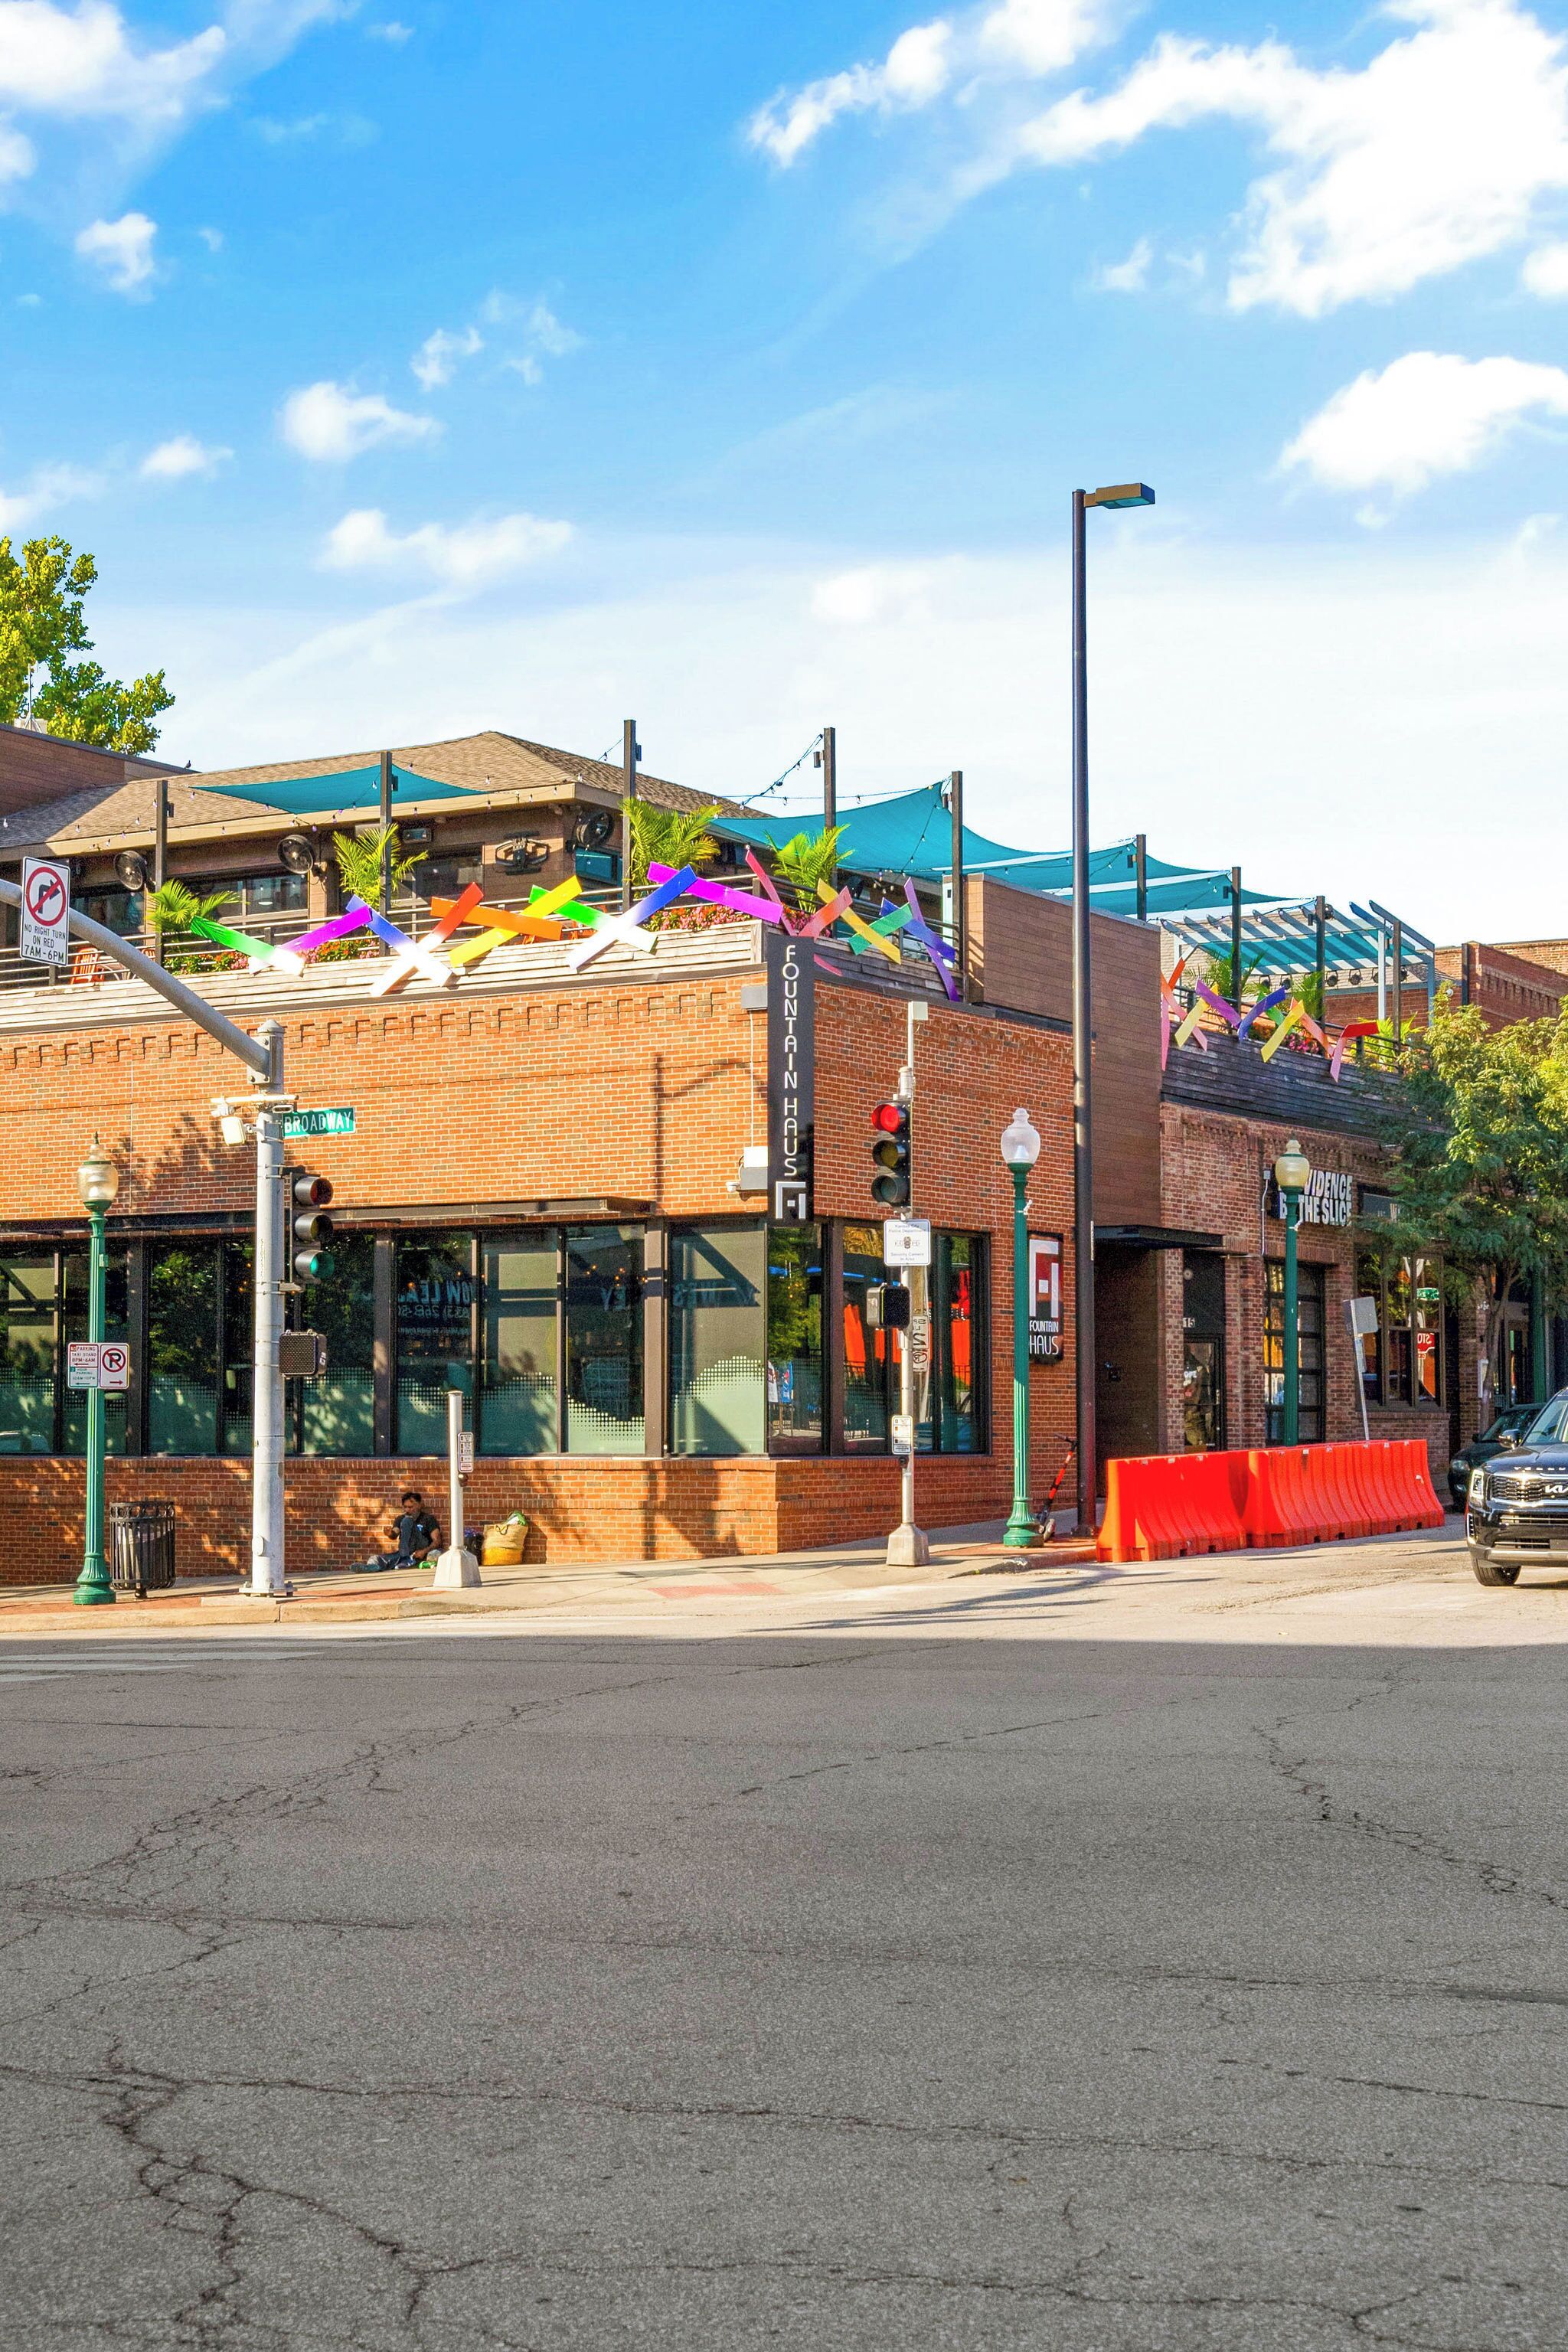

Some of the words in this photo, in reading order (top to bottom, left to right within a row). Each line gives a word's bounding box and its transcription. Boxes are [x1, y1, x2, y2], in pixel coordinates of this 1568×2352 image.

[24, 923, 32, 933] NO
[34, 926, 50, 936] RIGHT
[52, 929, 66, 940] TURN
[33, 935, 41, 945] ON
[44, 937, 54, 949] RED
[782, 945, 799, 1089] FOUNTAIN
[284, 1111, 351, 1133] BROADWAY
[784, 1097, 798, 1177] HAUS
[1303, 1169, 1353, 1202] VIDENCE
[1321, 1197, 1352, 1227] SLICE
[1029, 1320, 1059, 1333] FOUNTAIN
[1029, 1334, 1060, 1355] HAUS
